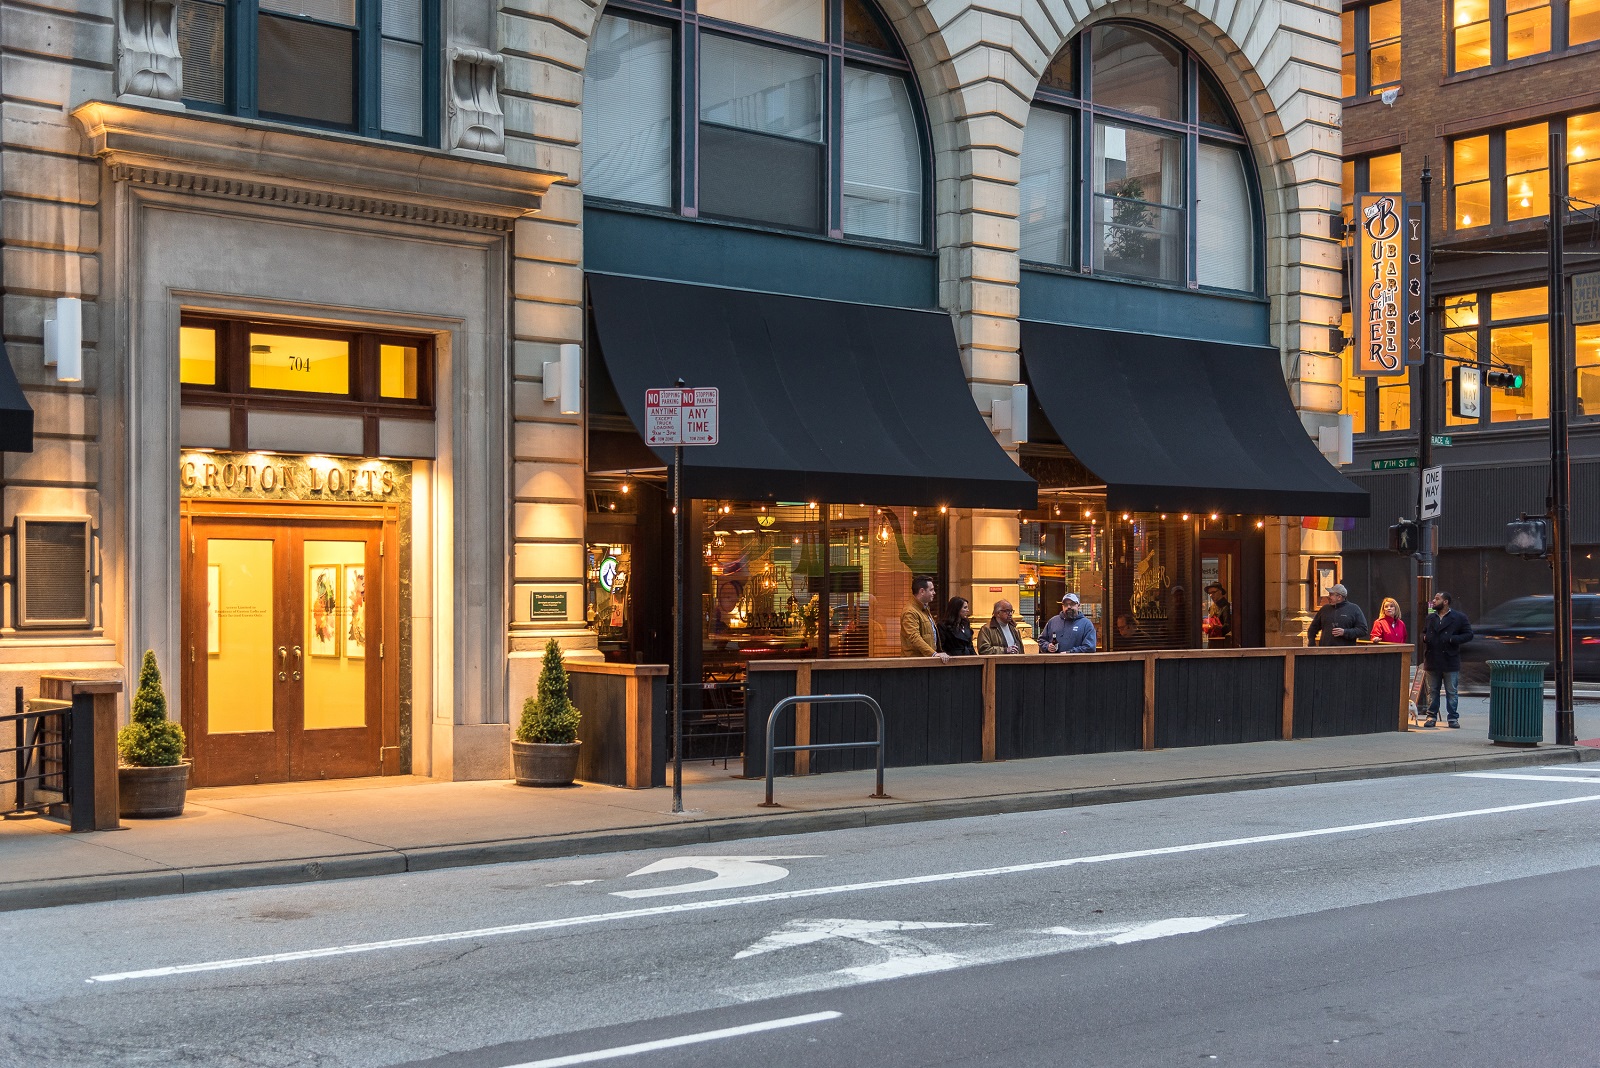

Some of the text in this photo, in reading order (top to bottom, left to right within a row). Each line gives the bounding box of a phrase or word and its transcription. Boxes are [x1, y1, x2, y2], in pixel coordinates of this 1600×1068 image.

[1362, 196, 1400, 370] BUTCHER
[1574, 300, 1600, 314] VEH
[289, 356, 311, 372] 704
[1464, 372, 1476, 386] ONE
[648, 393, 659, 404] NO
[683, 392, 694, 404] NO
[1464, 388, 1476, 400] WAY
[688, 409, 708, 419] ANY
[687, 422, 709, 432] TIME
[181, 461, 394, 496] GROTON LOFTS
[1426, 472, 1439, 484] ONE
[1425, 485, 1439, 498] WAY
